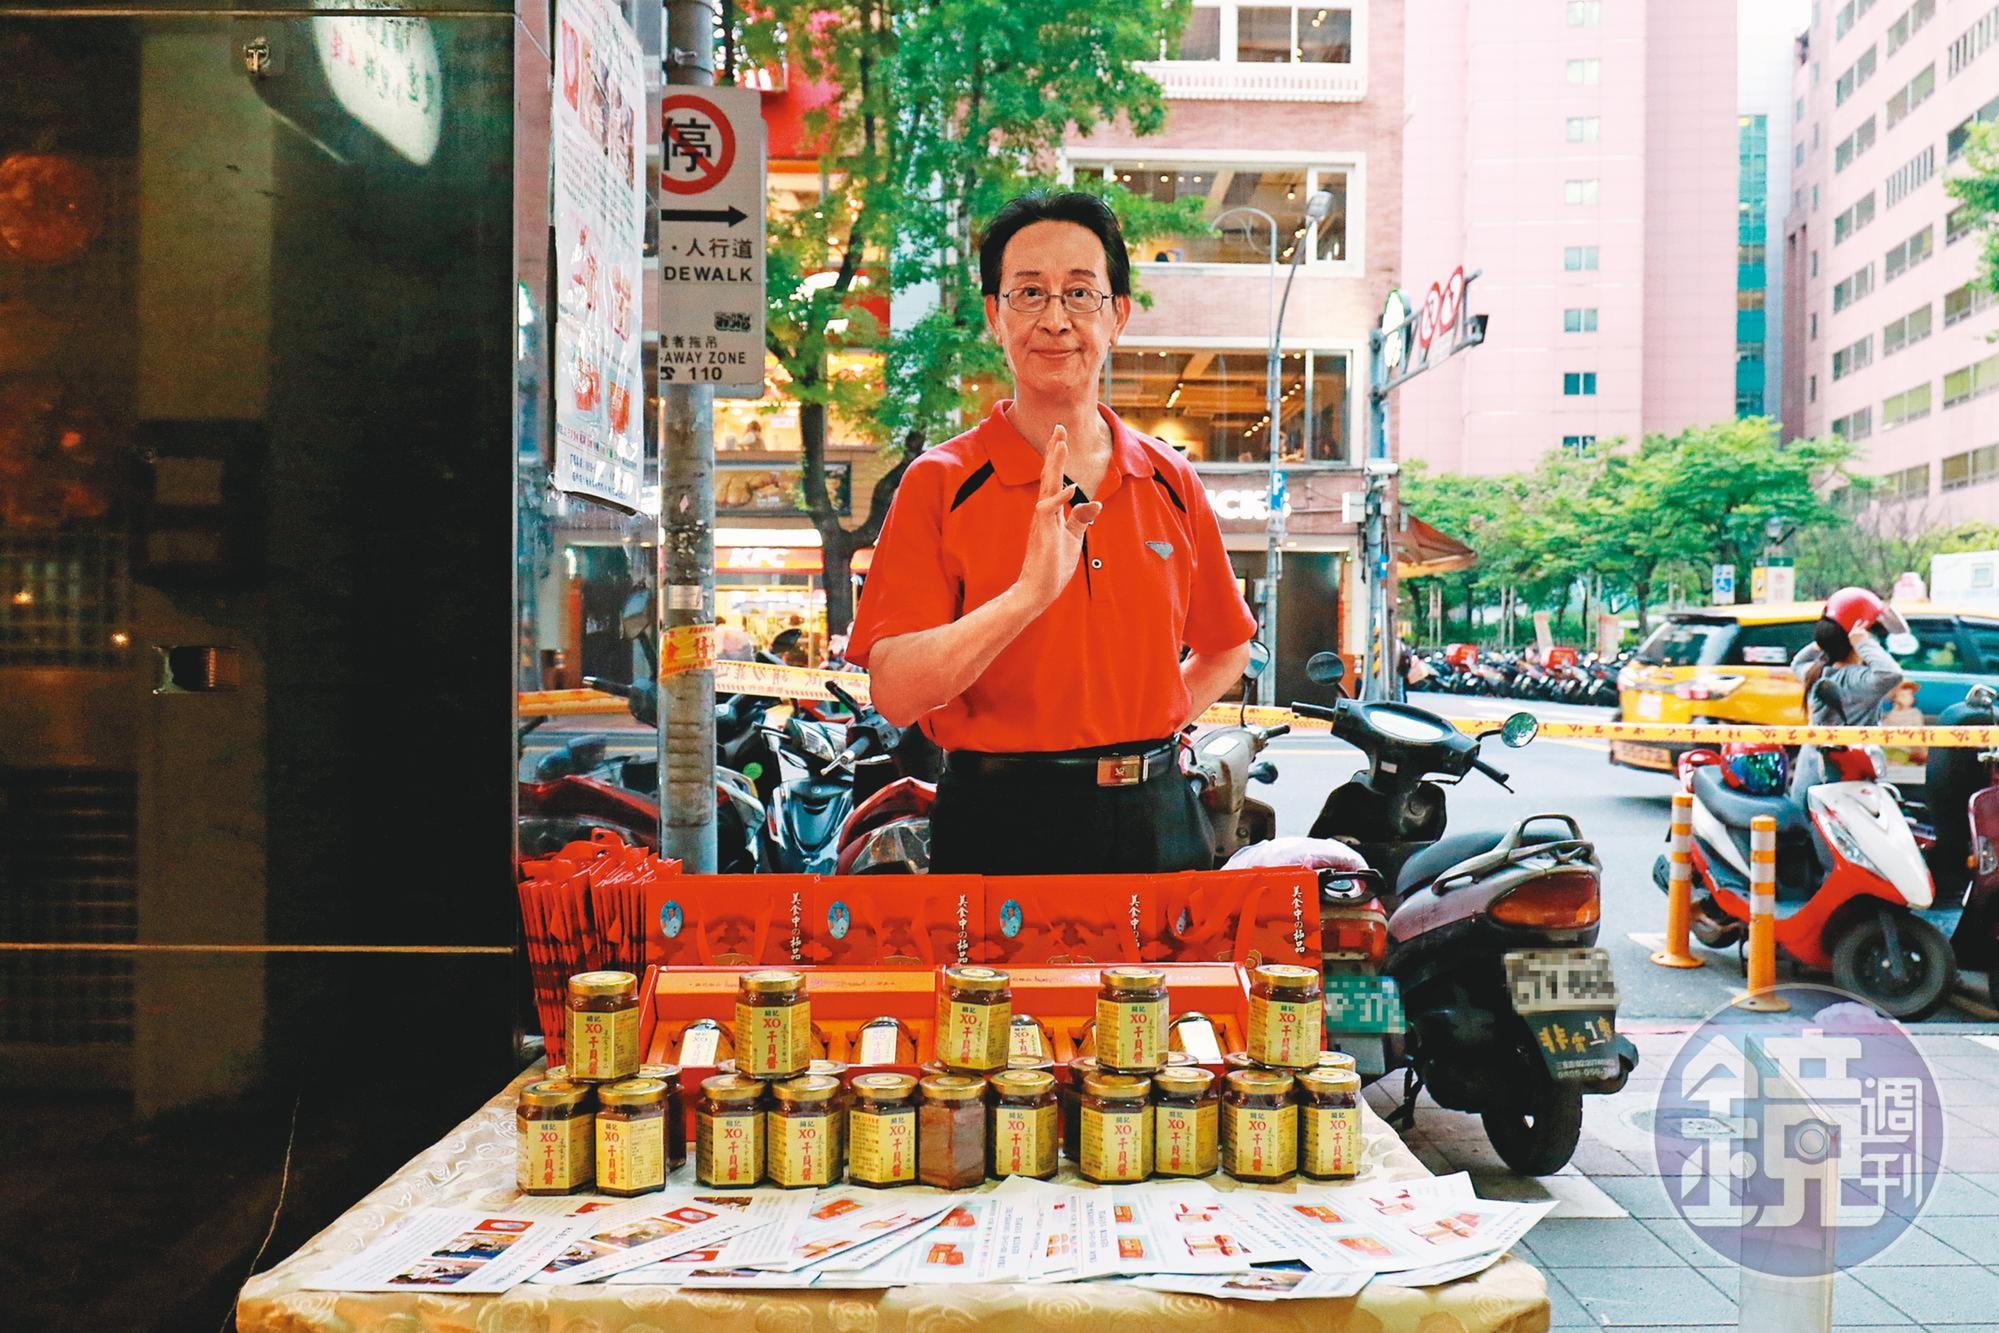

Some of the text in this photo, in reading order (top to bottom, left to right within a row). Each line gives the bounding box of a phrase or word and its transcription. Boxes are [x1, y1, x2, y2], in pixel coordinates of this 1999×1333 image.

[662, 118, 711, 172] 停
[664, 266, 752, 281] DEWALK
[708, 352, 746, 364] ZONE
[689, 367, 722, 380] 110
[763, 1018, 781, 1028] XO
[959, 1014, 977, 1025] XO
[1130, 1013, 1147, 1024] XO
[1278, 1012, 1296, 1024] XO
[585, 1024, 602, 1034] XO
[1007, 1120, 1025, 1131] XO
[1114, 1123, 1132, 1135] XO
[1167, 1118, 1185, 1130] XO
[1248, 1119, 1267, 1131] XO
[1329, 1119, 1347, 1130] XO
[604, 1131, 620, 1142] XO
[725, 1128, 743, 1139] XO
[798, 1129, 816, 1140] XO
[889, 1125, 906, 1137] XO
[540, 1132, 558, 1143] XO
